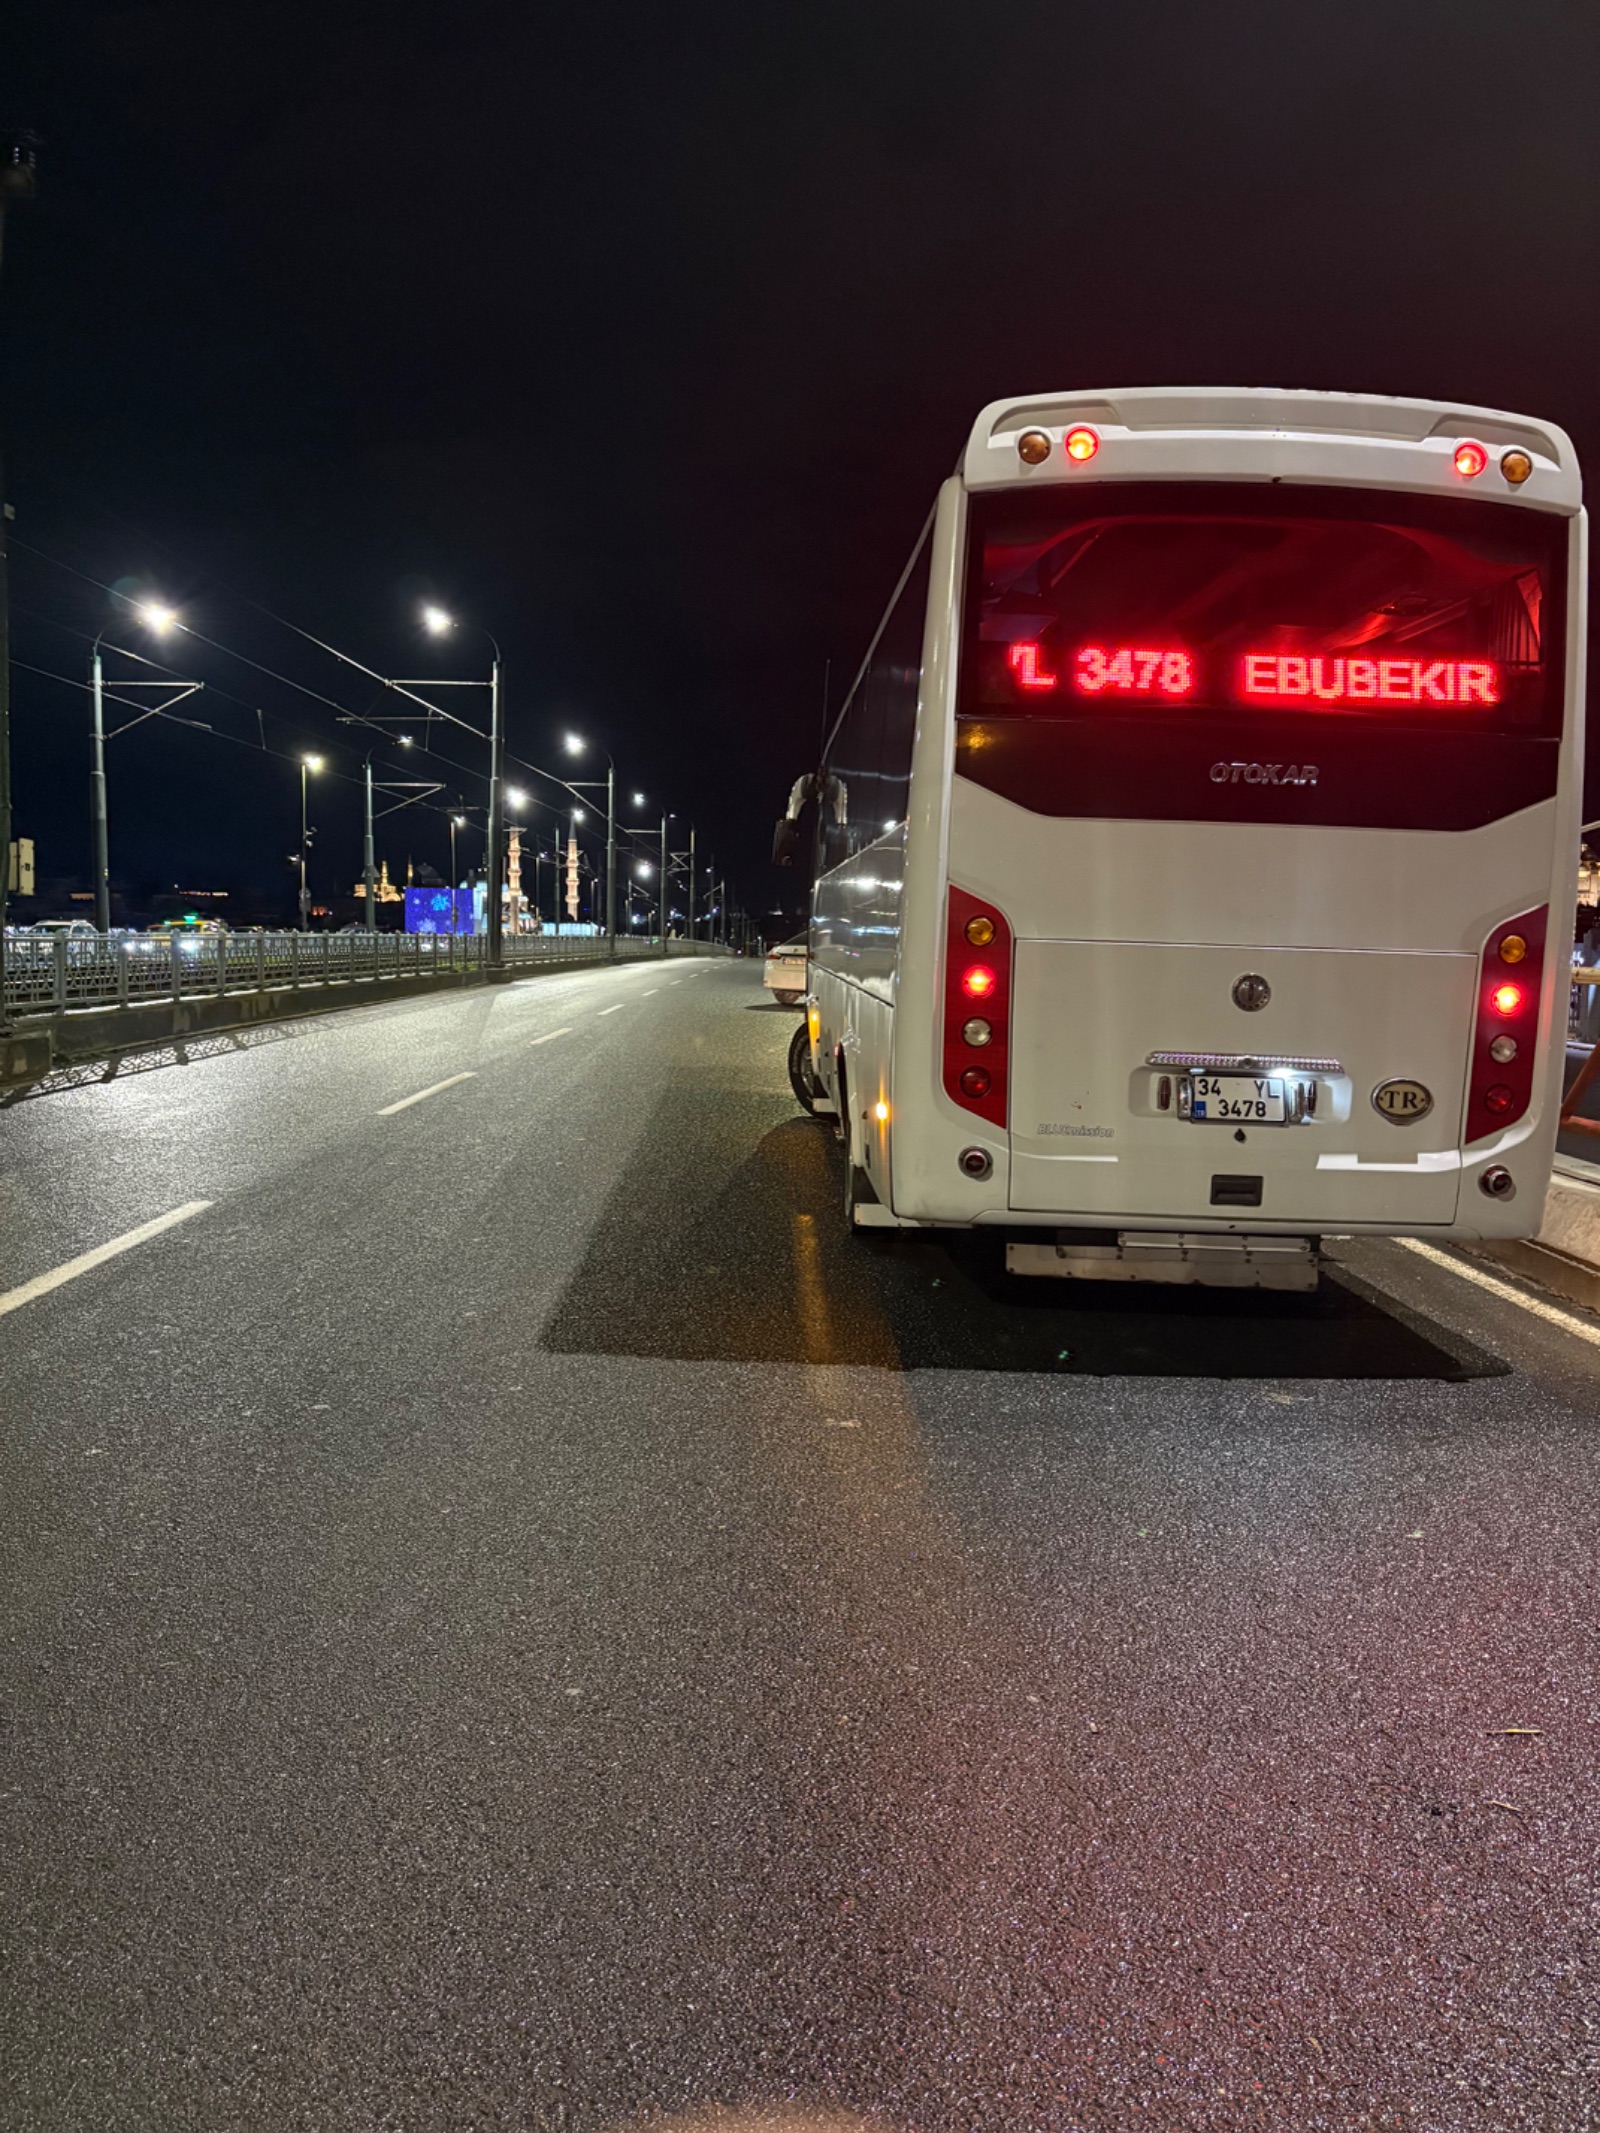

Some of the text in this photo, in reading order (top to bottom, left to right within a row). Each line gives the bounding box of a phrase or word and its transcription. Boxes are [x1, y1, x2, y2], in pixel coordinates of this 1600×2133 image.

[1078, 649, 1190, 693] 3478
[1245, 655, 1499, 702] EBUBEKIR
[1209, 762, 1320, 785] OTOKAR
[1198, 1079, 1280, 1098] 34 YL
[1218, 1100, 1267, 1117] 3478
[1384, 1091, 1418, 1109] TR
